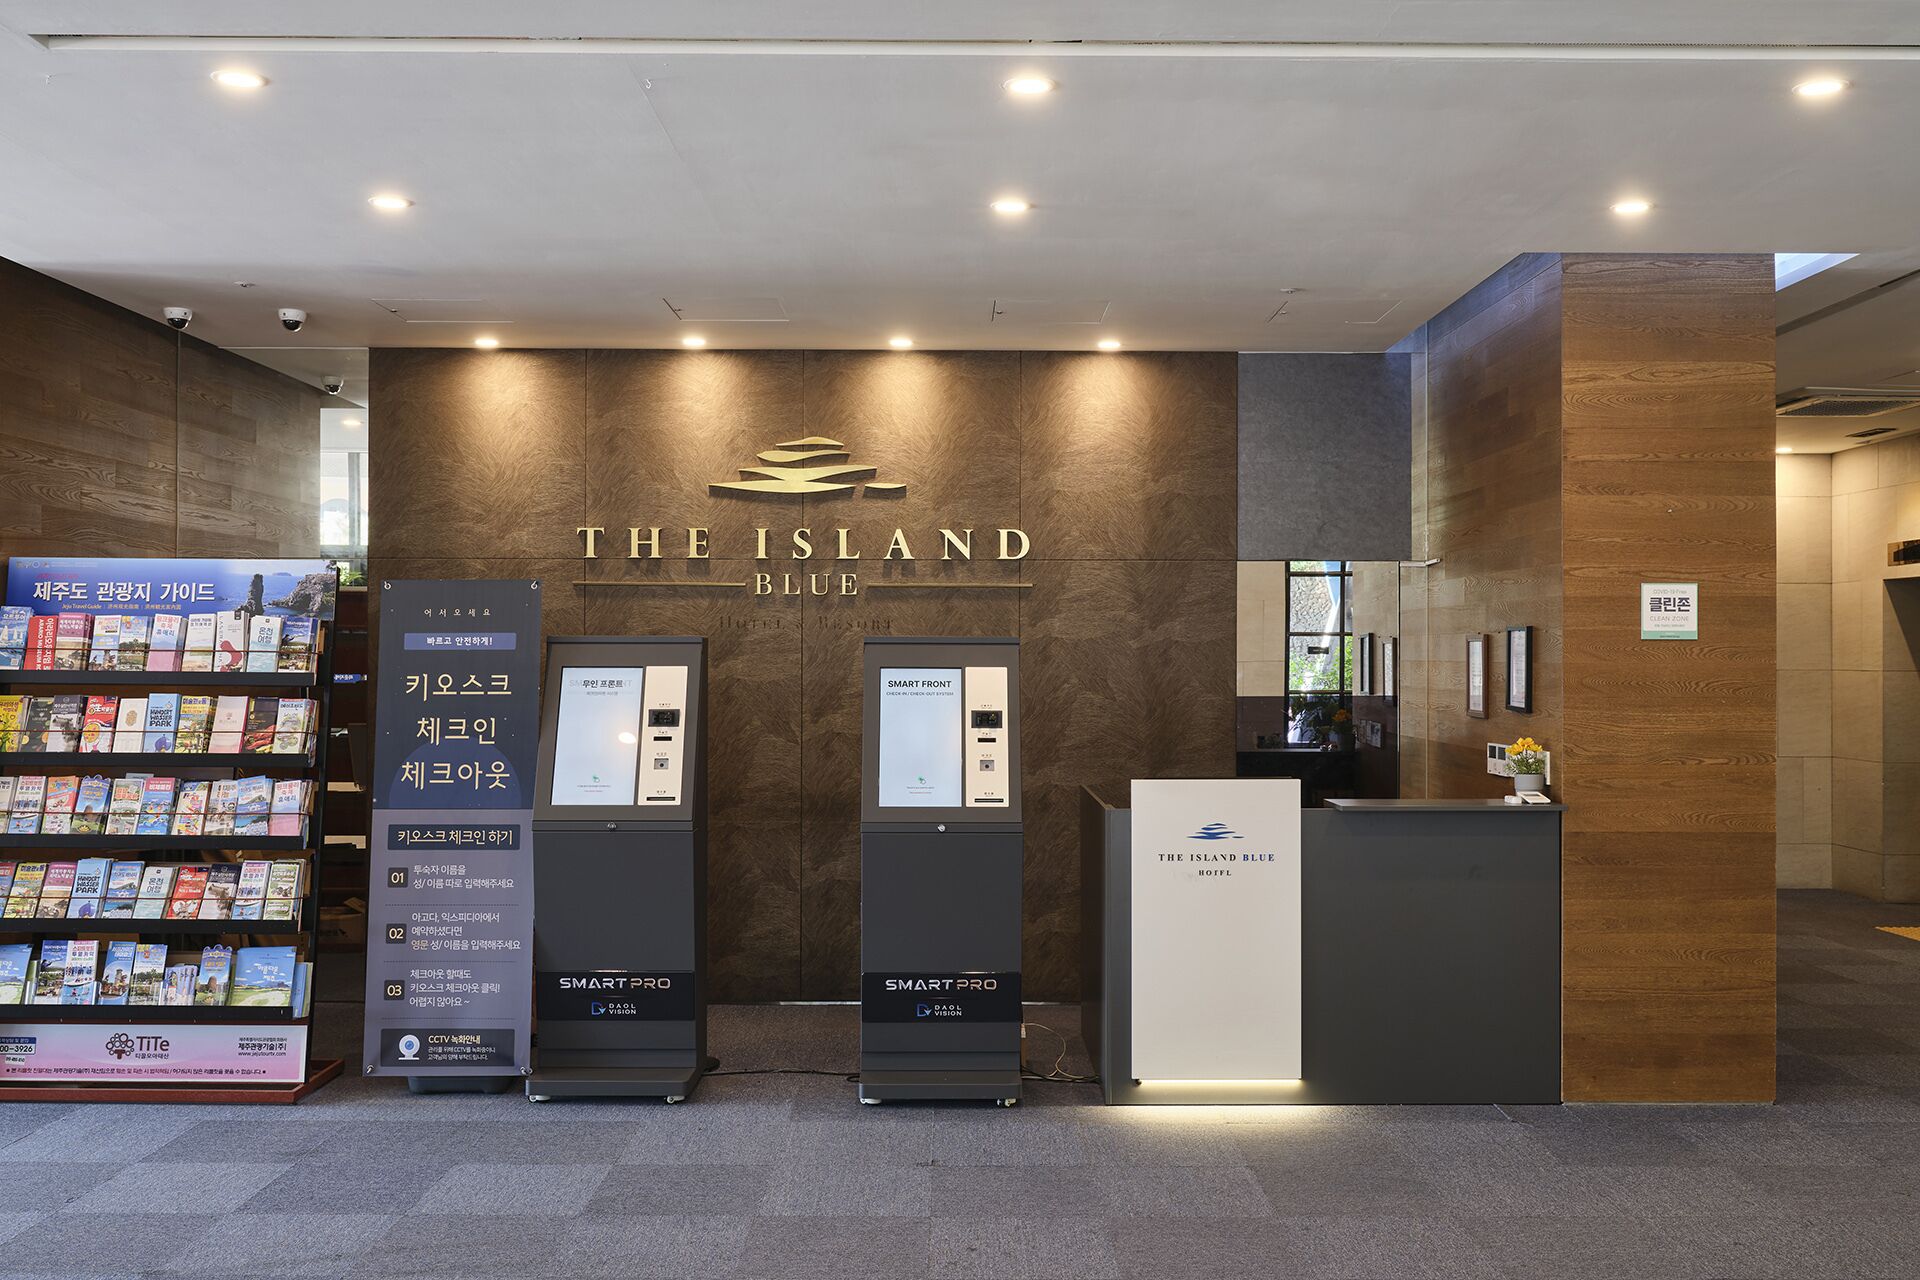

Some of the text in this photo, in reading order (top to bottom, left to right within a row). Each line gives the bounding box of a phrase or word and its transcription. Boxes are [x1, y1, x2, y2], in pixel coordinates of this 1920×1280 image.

[577, 527, 1031, 560] THE ISLAND
[755, 573, 858, 595] BLUE
[33, 581, 216, 603] 제주도 관광지 가이드
[1649, 597, 1690, 612] 클린존
[427, 637, 493, 646] 빠르고 안전하게!
[405, 673, 511, 701] 키오스크
[583, 680, 598, 688] 무인
[417, 717, 496, 746] 체크인
[400, 761, 510, 790] 체크아웃
[397, 830, 513, 845] 키오스크 체크인 하기
[1158, 853, 1275, 862] THE ISLAND BLUE
[413, 864, 466, 875] 투숙자 이름을
[391, 872, 404, 884] 01
[413, 878, 514, 889] 성/ 이름 따로 입력해주세요
[76, 886, 98, 894] PARK
[411, 912, 500, 923] 아고다, 익스피디아에서
[389, 928, 403, 939] 02
[411, 926, 462, 936] 예약하셨다면
[411, 940, 521, 950] 영문 성/ 이름을 입력해주세요
[410, 968, 472, 980] 체크아웃 할때도
[387, 985, 402, 996] 03
[410, 983, 501, 994] 키오스크 체크아웃 클릭!
[409, 997, 436, 1007] 어렵지
[437, 997, 463, 1007] 않아요
[136, 1036, 170, 1051] TiTe
[428, 1035, 481, 1045] CCTV 녹화안내
